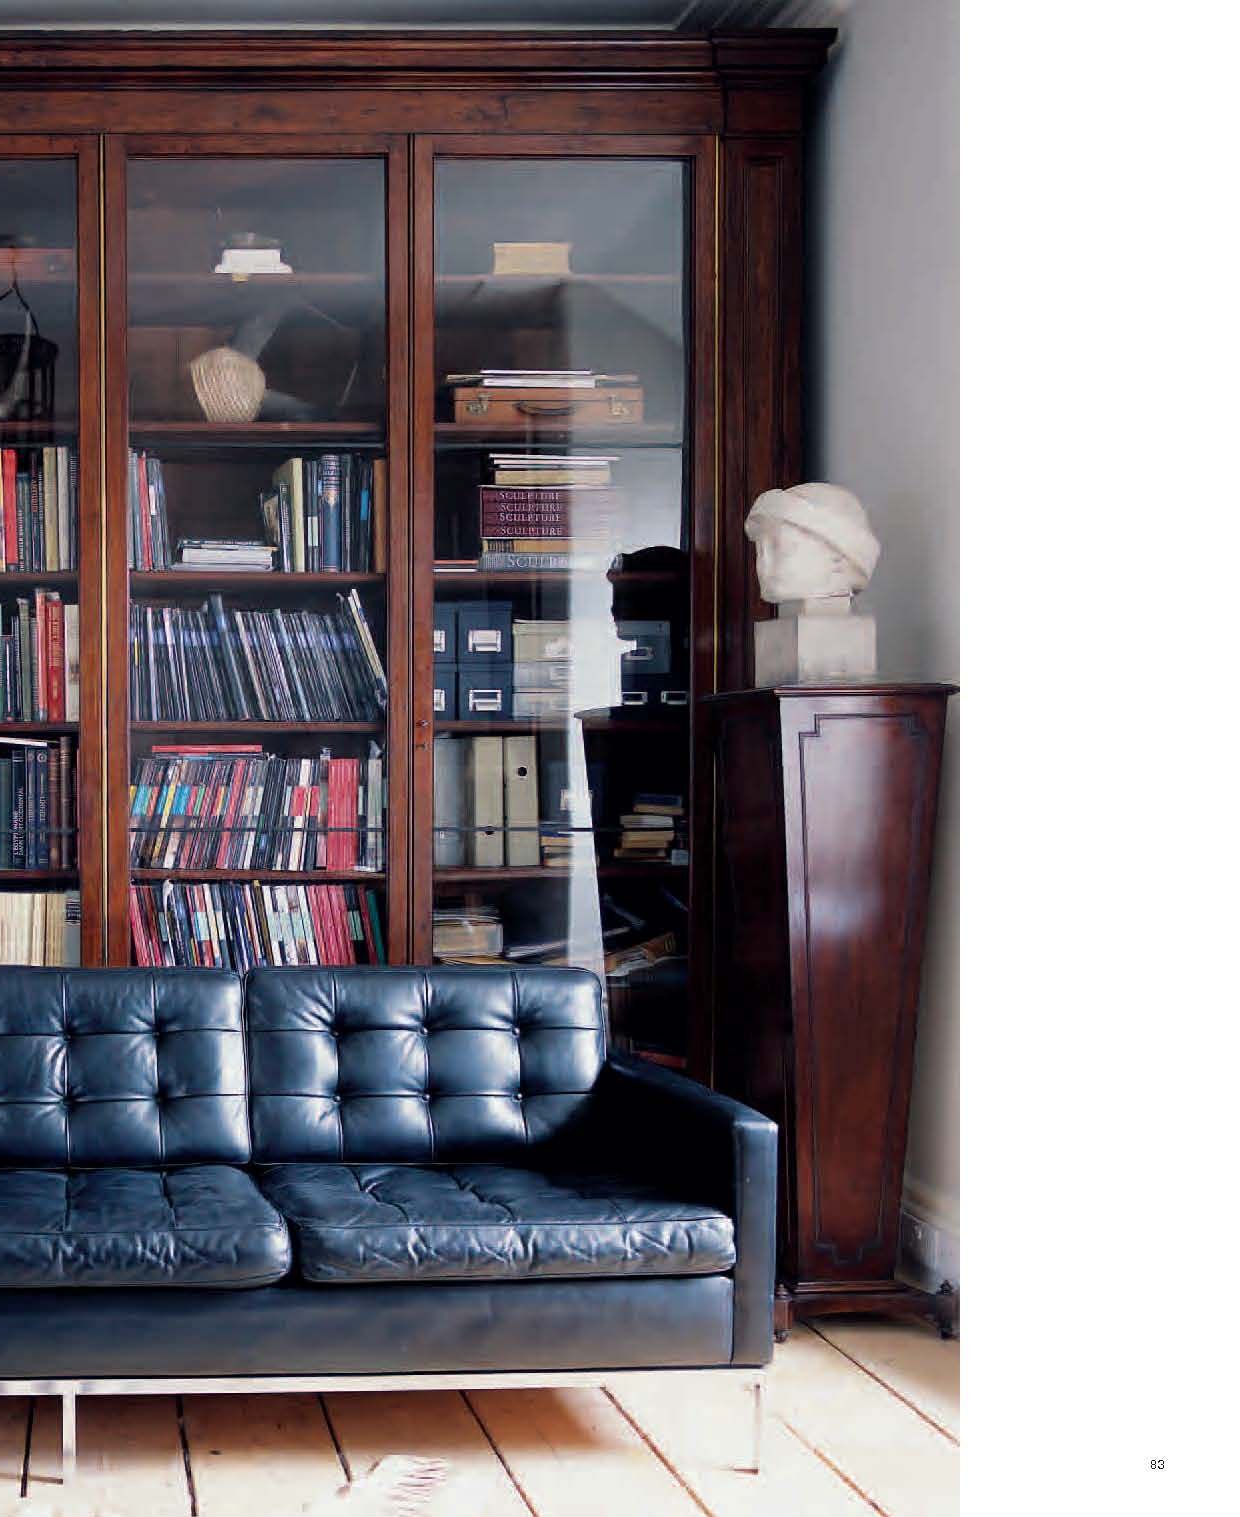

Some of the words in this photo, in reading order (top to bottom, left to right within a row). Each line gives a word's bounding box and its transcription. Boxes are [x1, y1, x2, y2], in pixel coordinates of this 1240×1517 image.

[499, 512, 561, 522] SCULPTURE
[500, 526, 562, 536] SCULPTURE
[1150, 1459, 1165, 1470] 83
